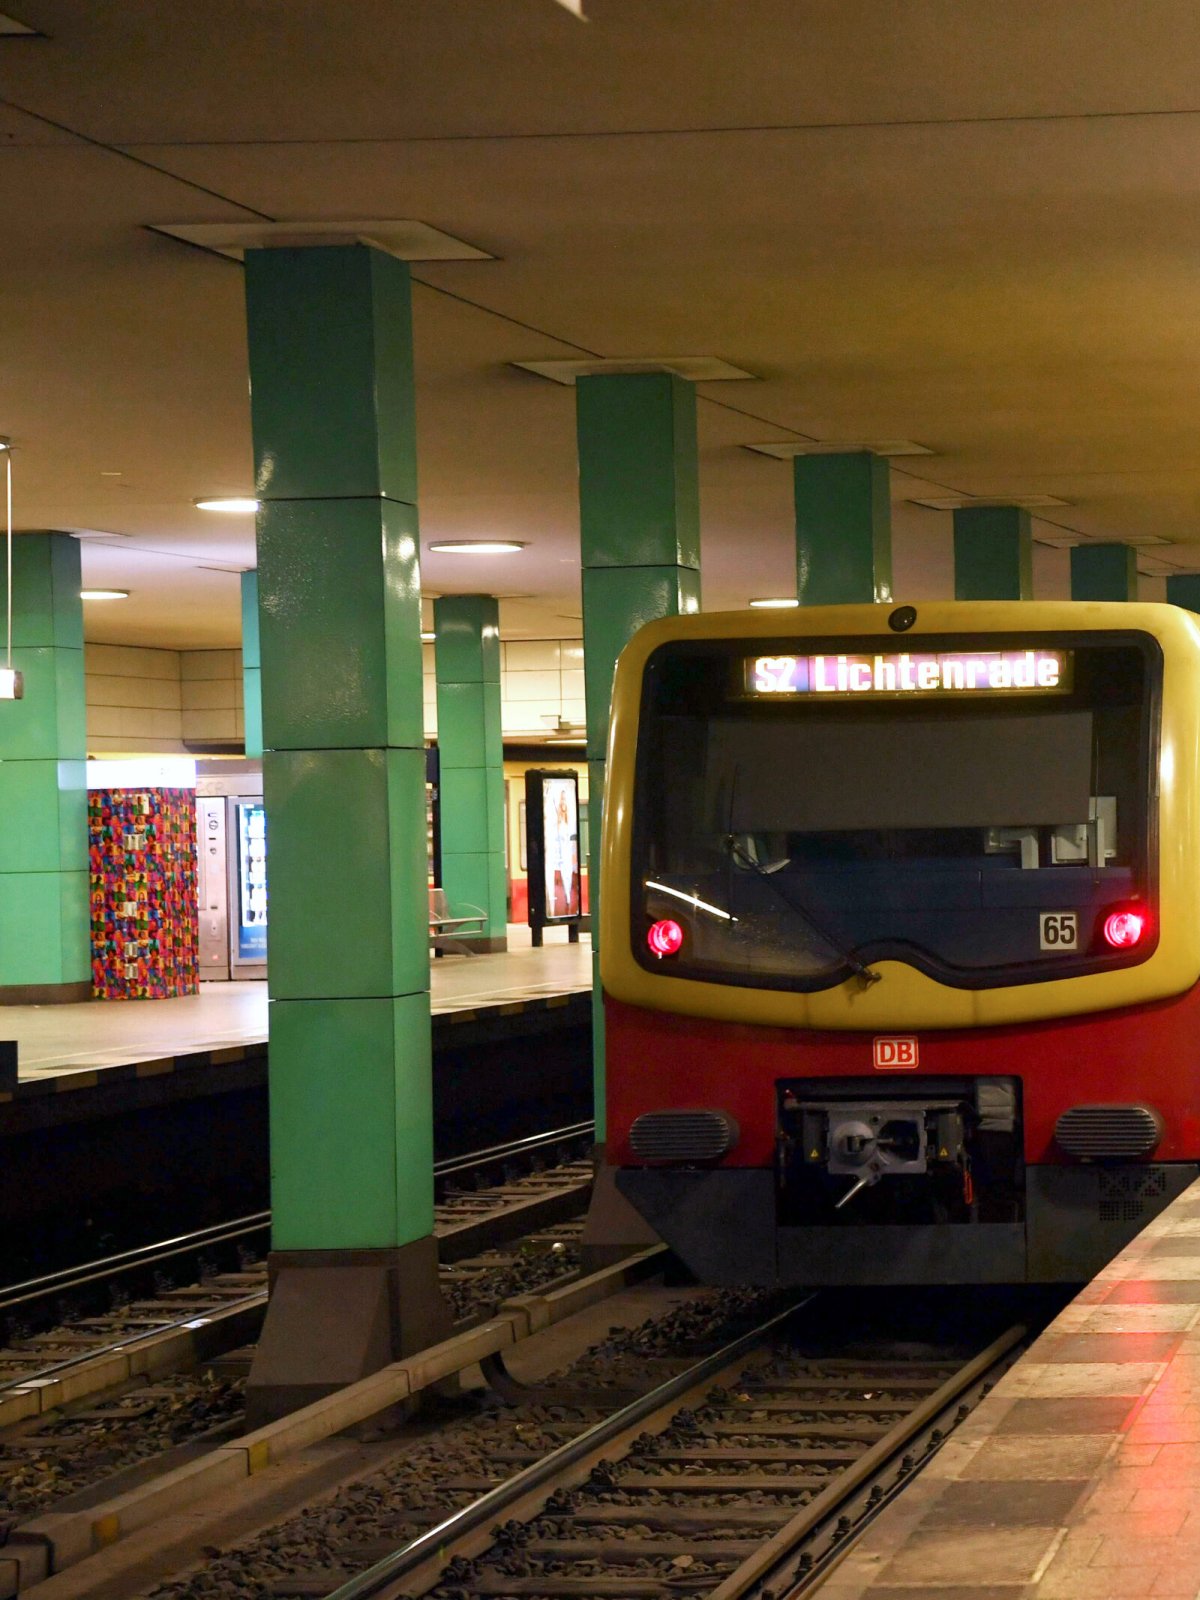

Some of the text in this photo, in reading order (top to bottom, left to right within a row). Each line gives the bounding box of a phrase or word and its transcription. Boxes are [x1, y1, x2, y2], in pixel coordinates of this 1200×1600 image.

[755, 650, 1060, 692] S2 Lichtenrade
[1043, 916, 1075, 945] 65
[879, 1040, 914, 1064] DB
